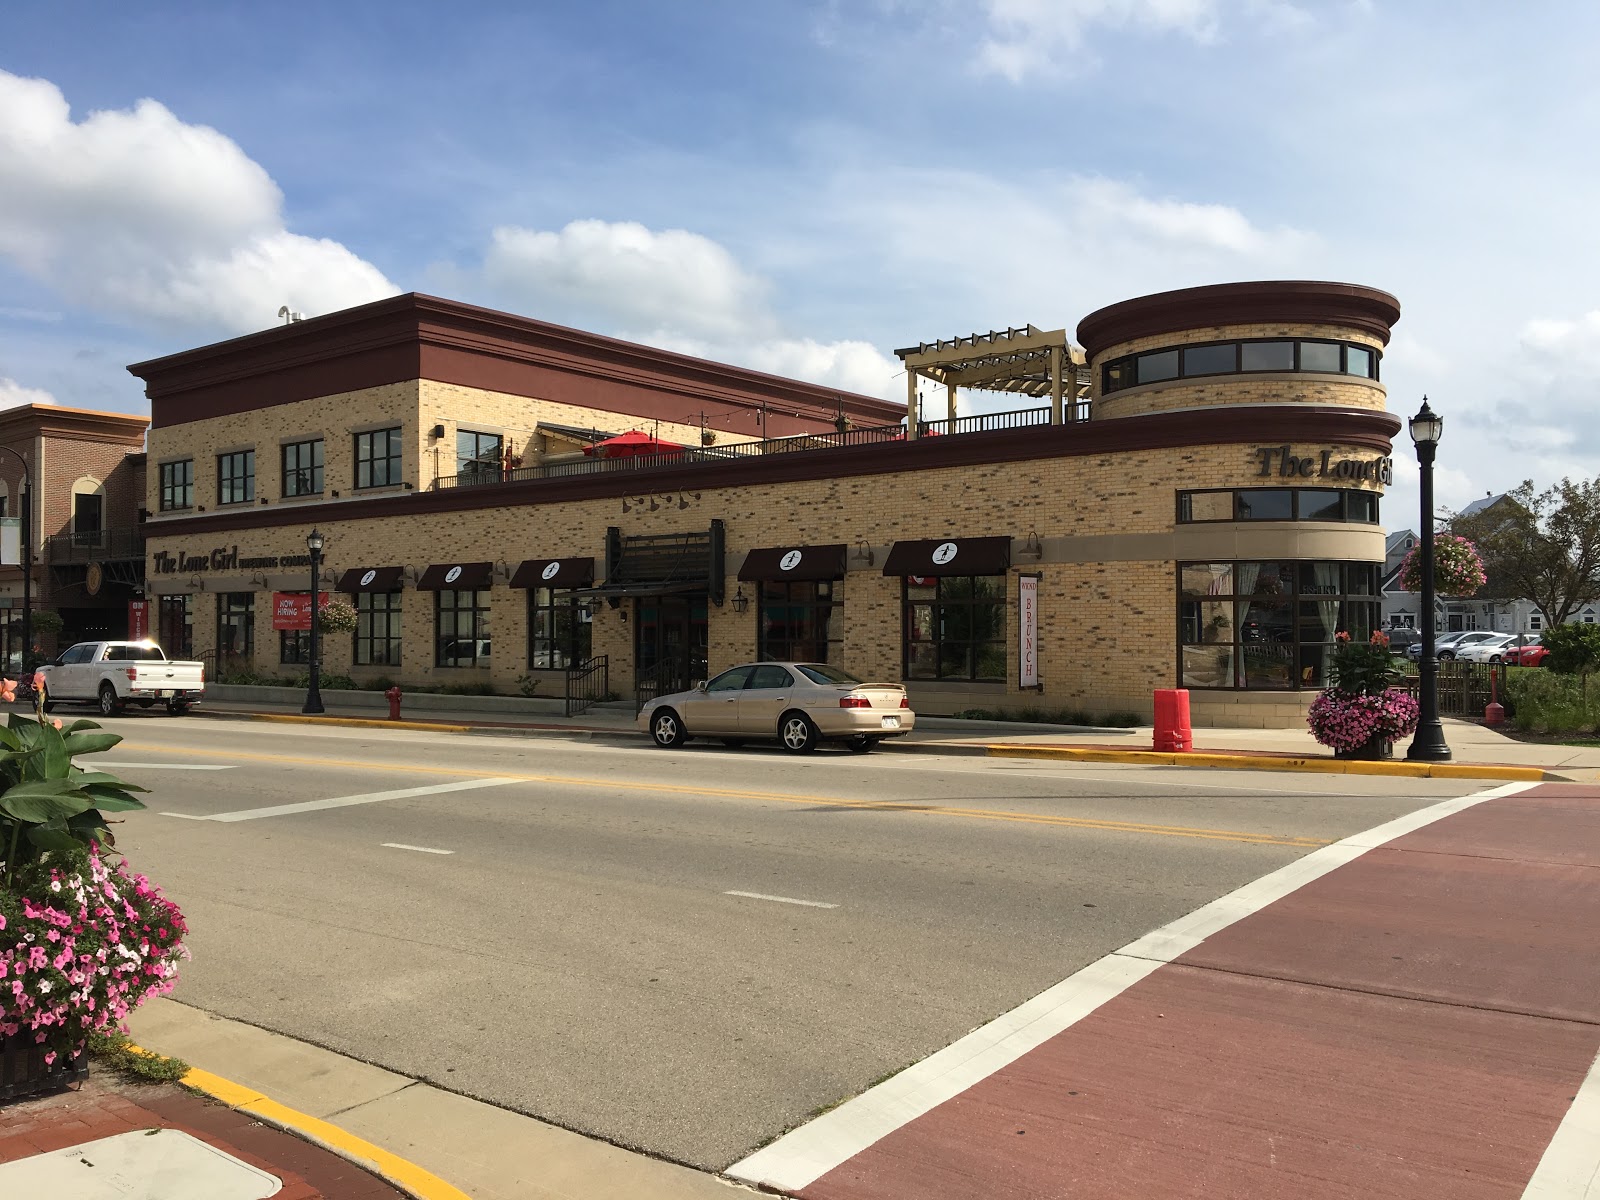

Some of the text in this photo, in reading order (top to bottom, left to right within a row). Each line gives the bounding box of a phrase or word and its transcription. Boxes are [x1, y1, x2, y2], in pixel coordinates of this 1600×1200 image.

[1255, 445, 1315, 478] The
[1317, 449, 1376, 481] Lone
[153, 550, 177, 574] The
[177, 550, 209, 573] Lone
[210, 545, 238, 571] Girl
[280, 553, 326, 567] COMPAY
[277, 607, 298, 616] HIRING
[279, 599, 295, 608] NOW
